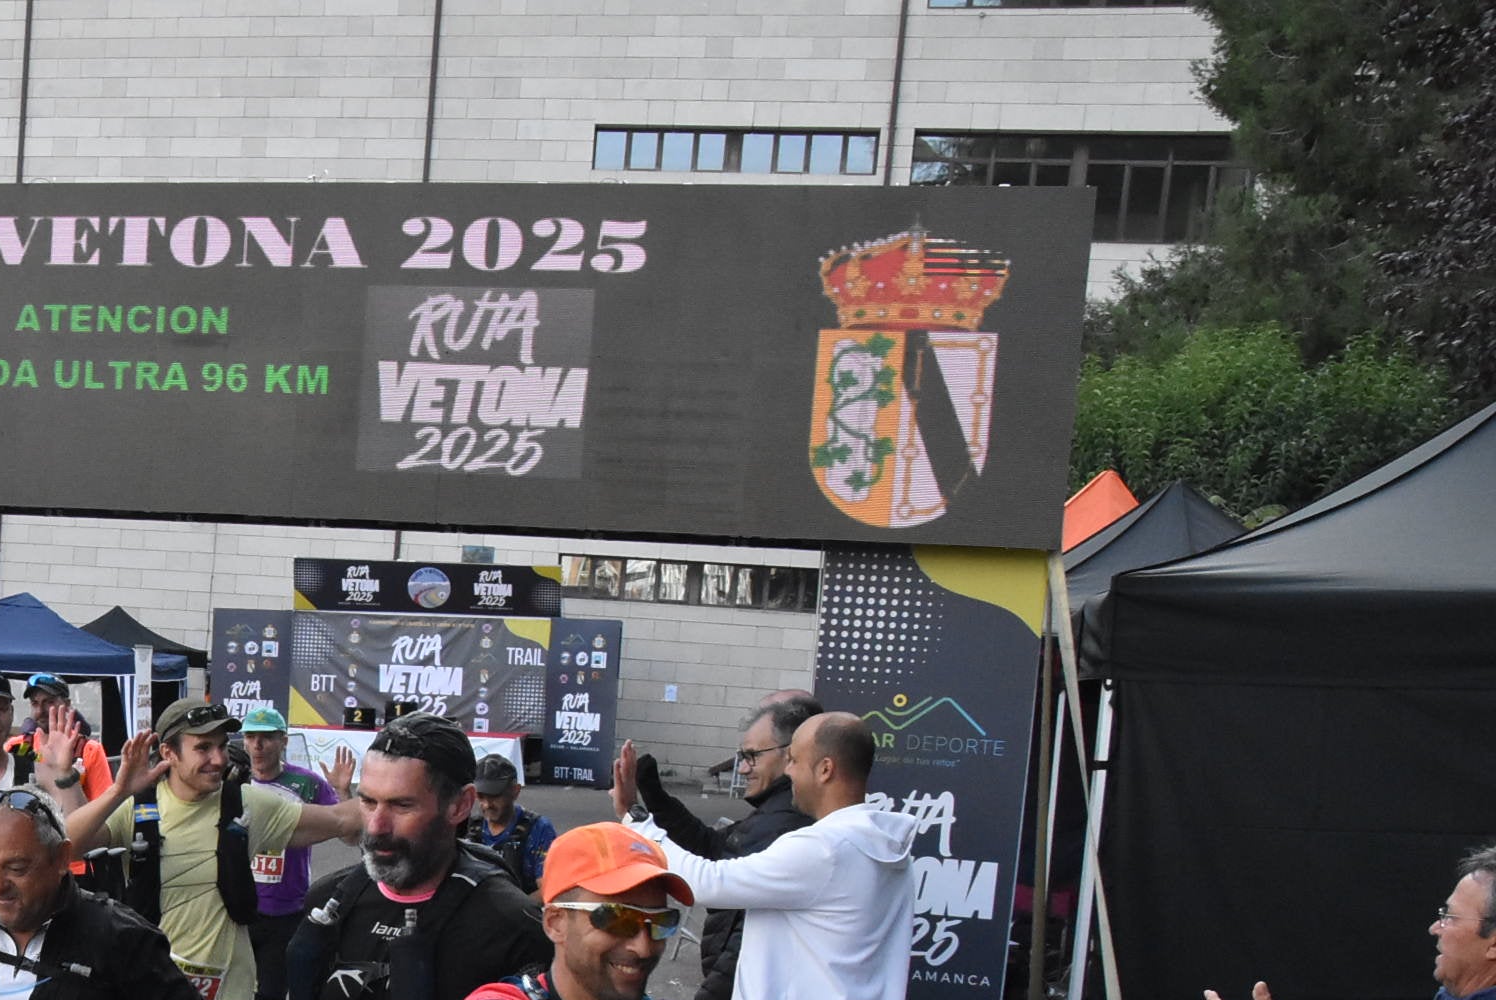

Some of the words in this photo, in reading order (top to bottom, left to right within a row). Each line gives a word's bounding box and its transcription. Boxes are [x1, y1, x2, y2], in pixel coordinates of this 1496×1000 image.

[400, 216, 648, 273] 2025
[15, 304, 230, 334] ATENCION
[407, 289, 540, 364] RUTA
[54, 360, 189, 391] ULTRA
[202, 362, 248, 392] 96
[264, 364, 329, 394] KM
[378, 360, 589, 429] VETONA
[396, 426, 547, 476] 2025
[345, 591, 374, 602] 2025
[477, 596, 506, 607] 2025
[391, 633, 443, 666] RUTA
[506, 647, 546, 667] TRAIL
[230, 680, 262, 700] RUTA
[310, 673, 338, 692] BTT
[379, 664, 464, 697] VETONA
[561, 692, 590, 713] RUTA
[353, 710, 363, 723] 2
[555, 711, 601, 732] VETONA
[558, 730, 592, 746] 2025
[906, 734, 1007, 757] DEPORTE
[251, 856, 278, 872] 014
[911, 855, 1000, 920] ONA
[910, 917, 962, 967] 25
[912, 969, 991, 987] AMANCA
